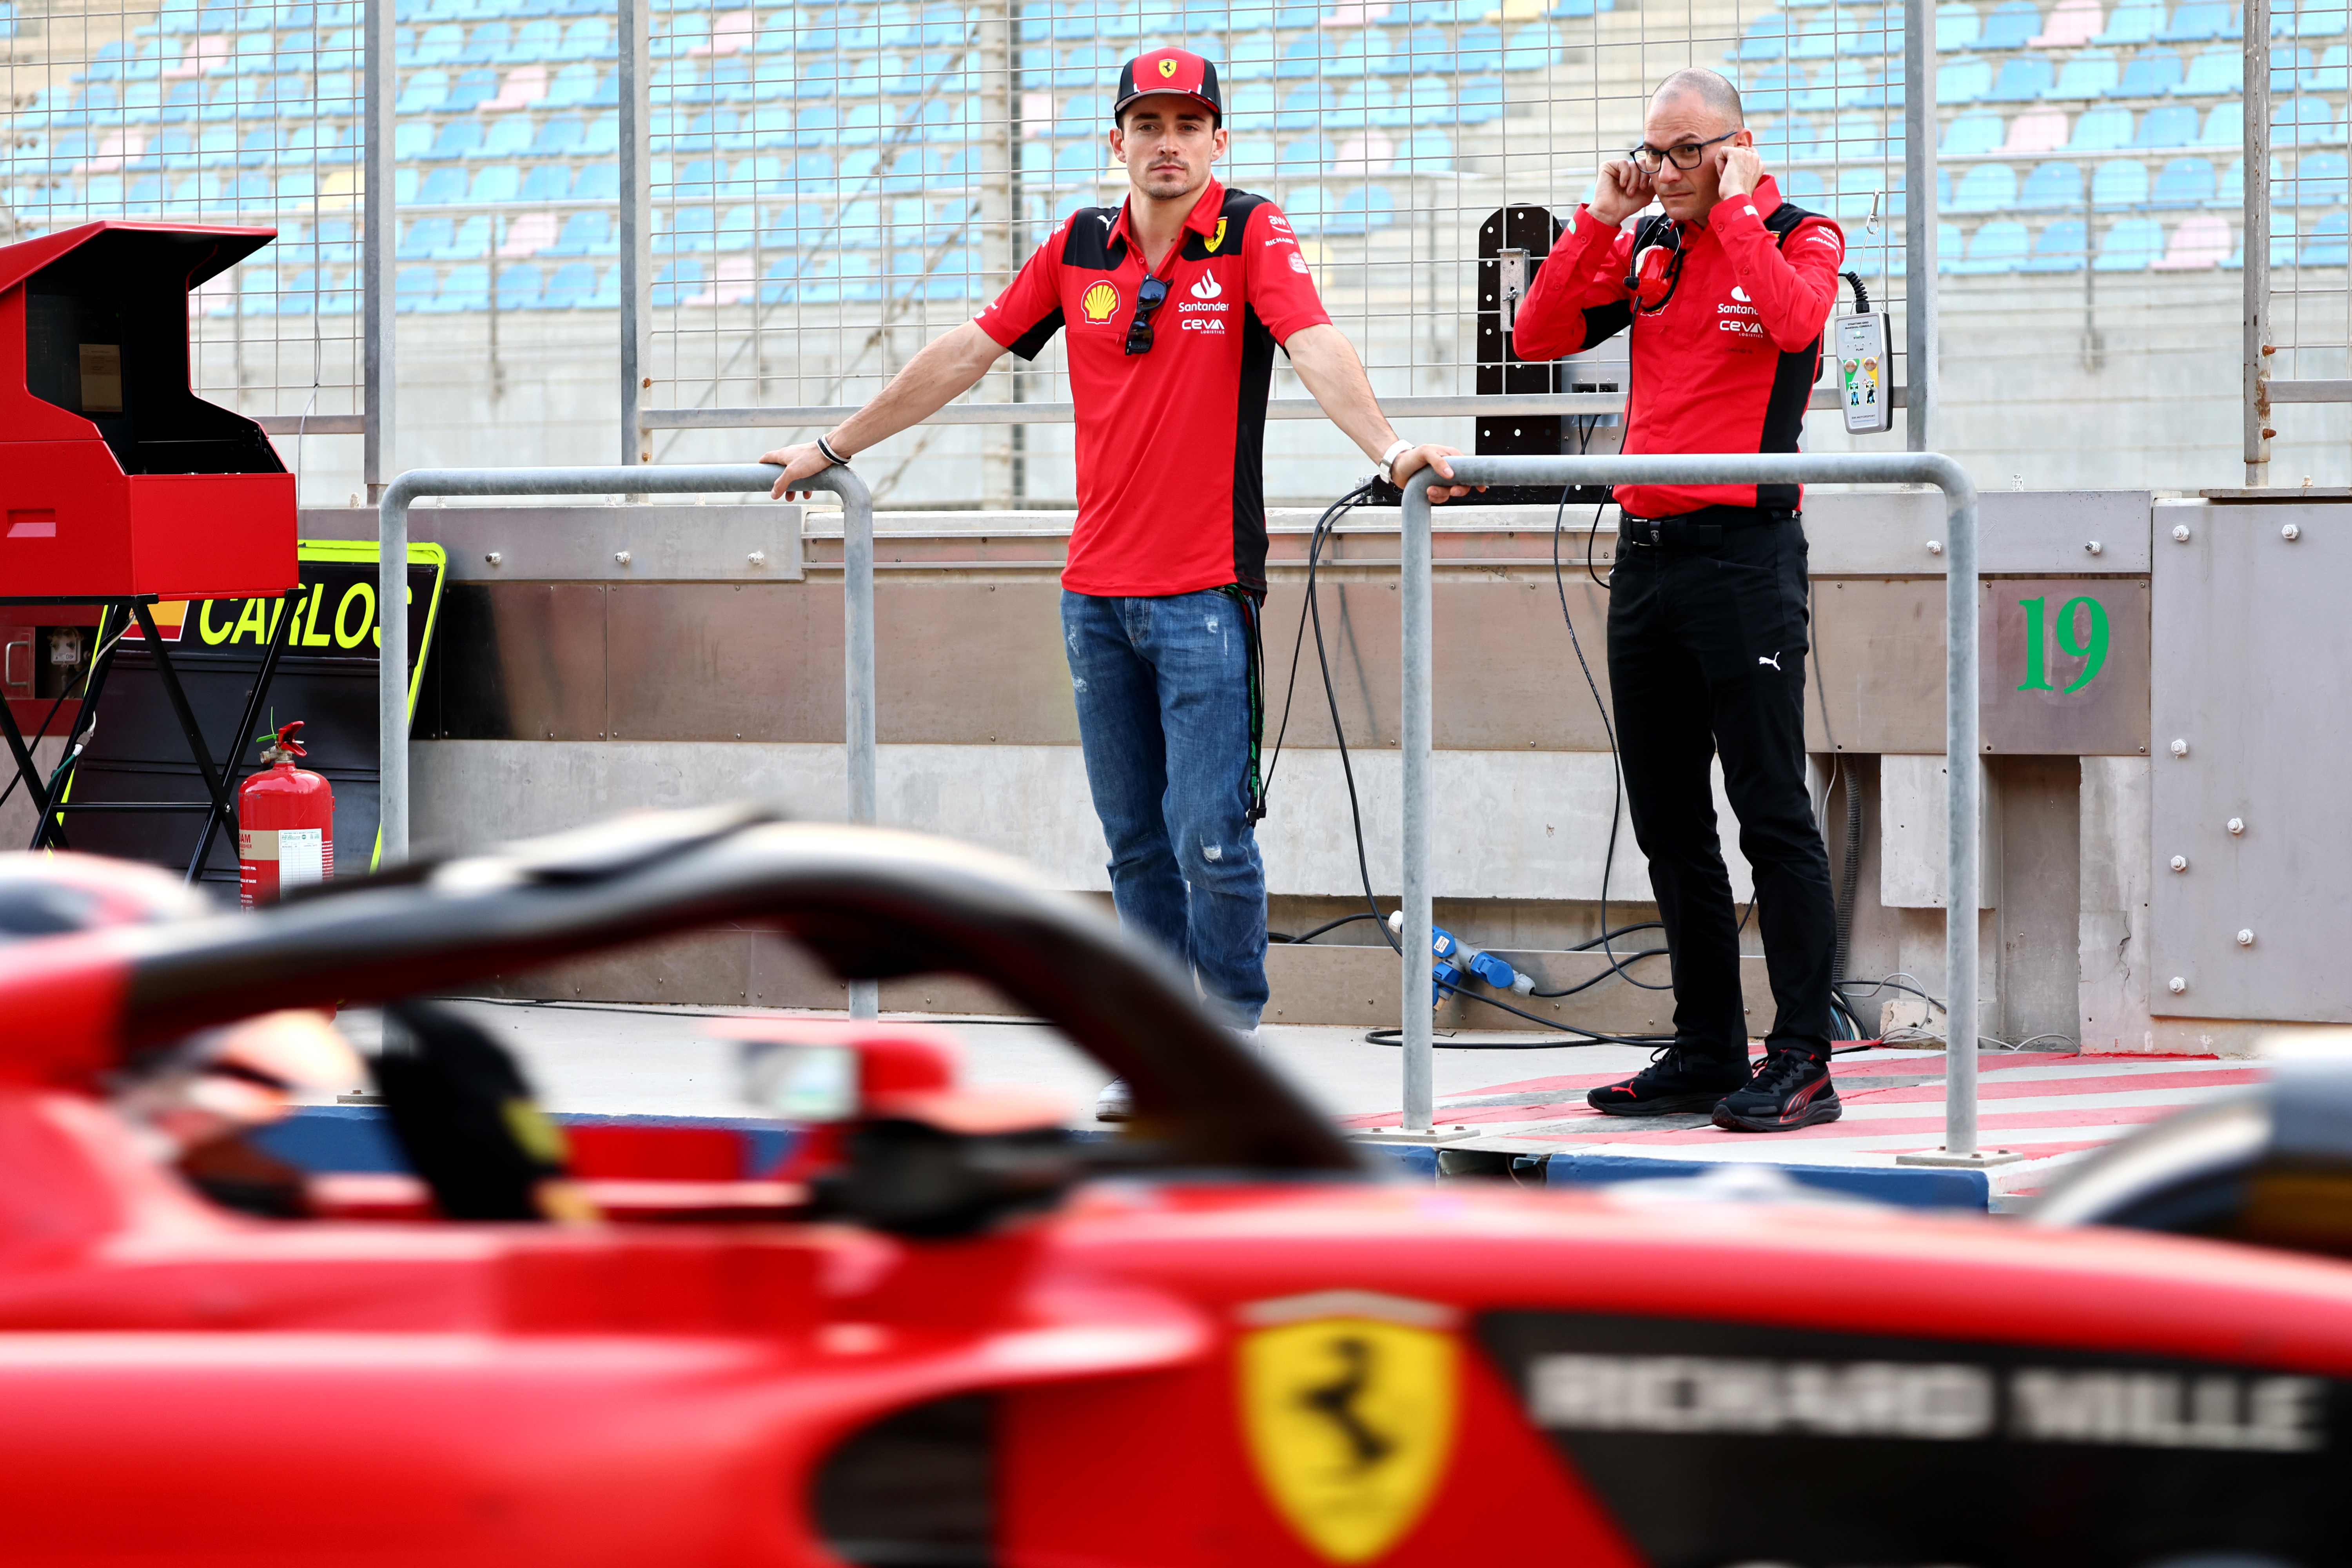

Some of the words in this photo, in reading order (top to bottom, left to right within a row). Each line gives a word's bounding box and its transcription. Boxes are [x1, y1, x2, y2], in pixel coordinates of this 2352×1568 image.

[1265, 238, 1294, 246] RICHARD
[1178, 301, 1229, 312] Santander
[1717, 303, 1759, 315] Santan
[2017, 596, 2109, 695] 19
[239, 834, 250, 843] OAM
[1529, 1352, 1995, 1441] RICHARD
[2009, 1370, 2328, 1452] MILLE
